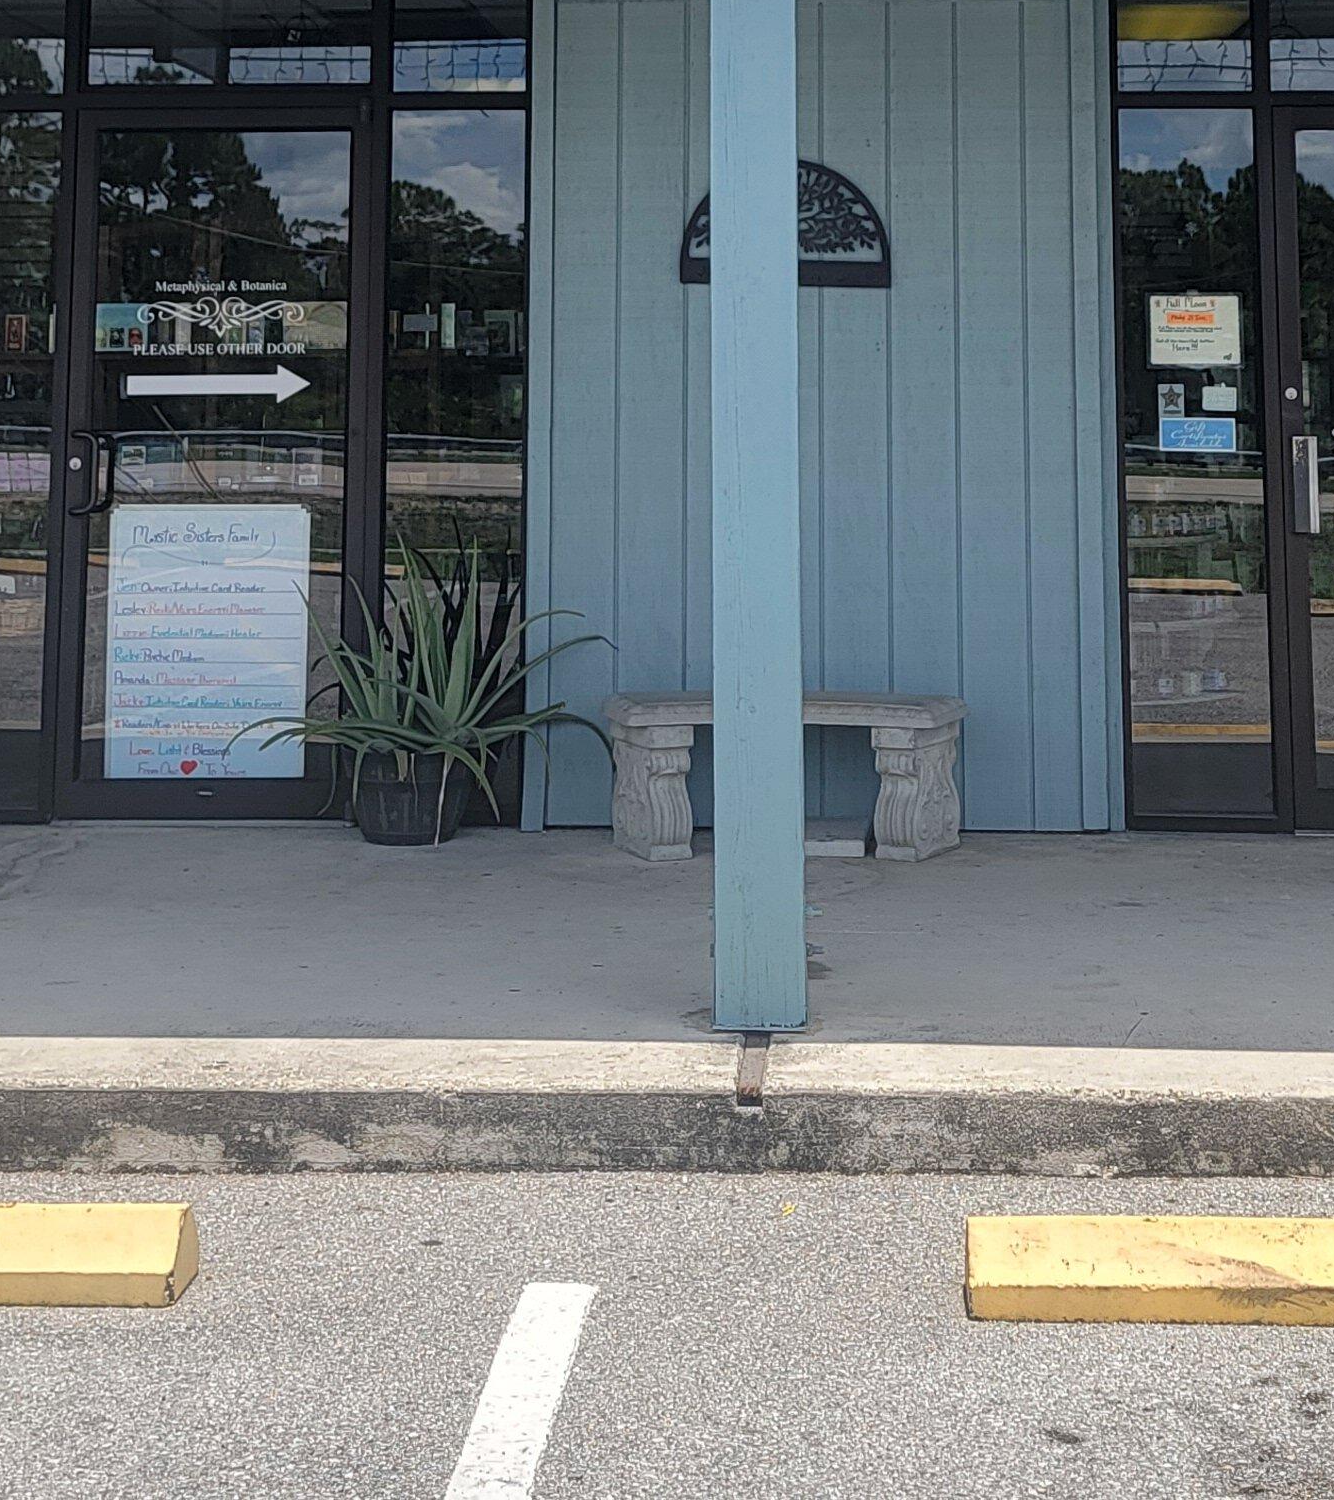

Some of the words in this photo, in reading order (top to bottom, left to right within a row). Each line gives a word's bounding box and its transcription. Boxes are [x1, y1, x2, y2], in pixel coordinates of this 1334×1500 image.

[155, 280, 225, 294] Metaphysical
[227, 280, 238, 291] &
[241, 280, 287, 291] Botanica
[133, 344, 185, 355] PLEASE
[191, 343, 214, 355] USE
[217, 343, 263, 355] OTHER
[267, 343, 306, 354] DOOR
[183, 522, 225, 543] Sisters
[228, 523, 260, 543] Family
